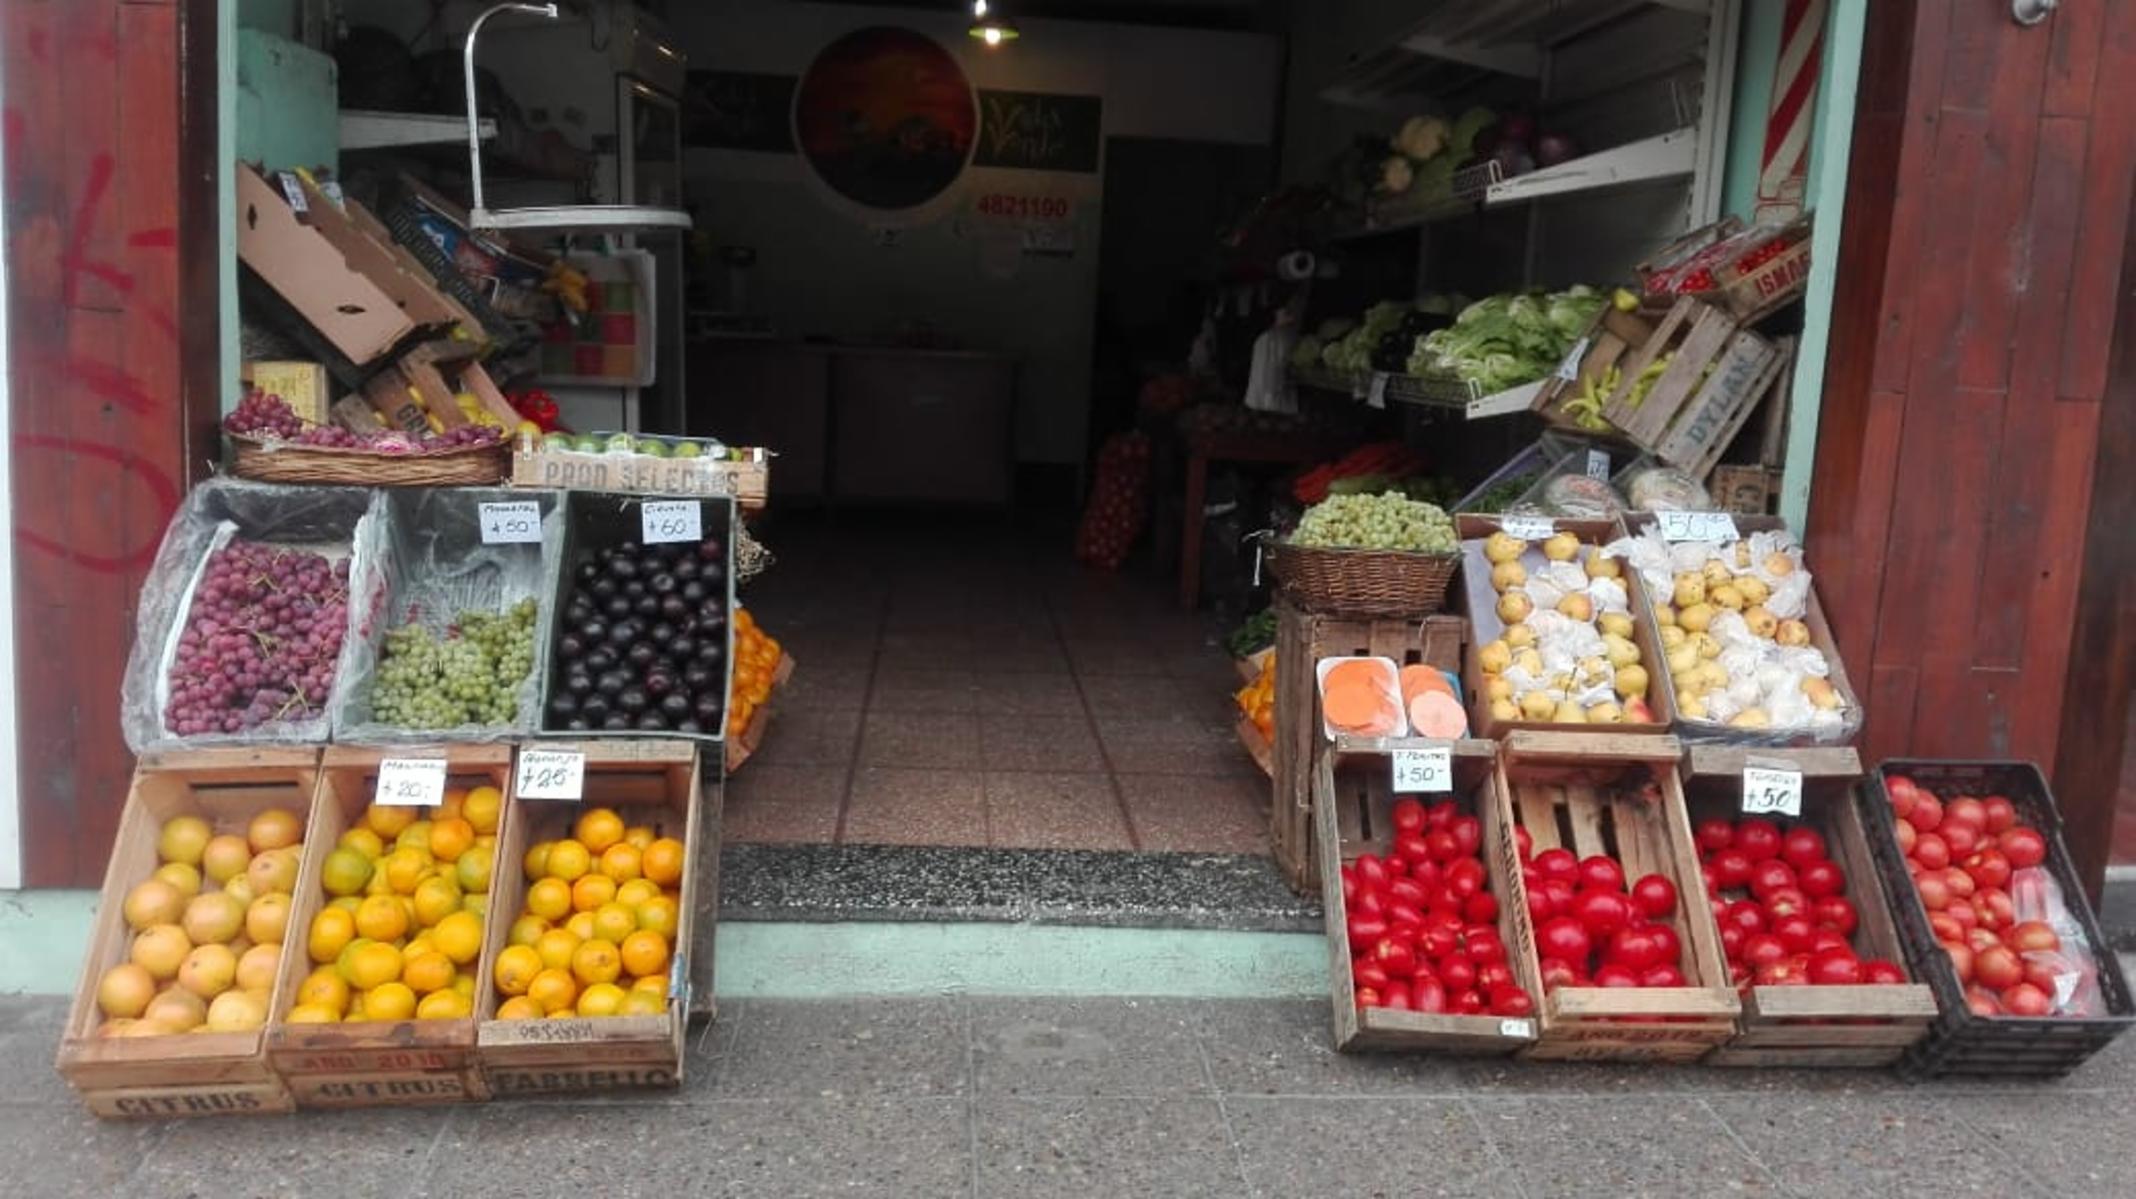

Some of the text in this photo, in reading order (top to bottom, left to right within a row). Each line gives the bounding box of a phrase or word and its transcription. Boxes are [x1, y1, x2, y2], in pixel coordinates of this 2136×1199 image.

[1686, 356, 1755, 445] DYLAN
[544, 462, 608, 487] PROD
[319, 1078, 461, 1099] CITRUS
[114, 1090, 262, 1115] CITRUS
